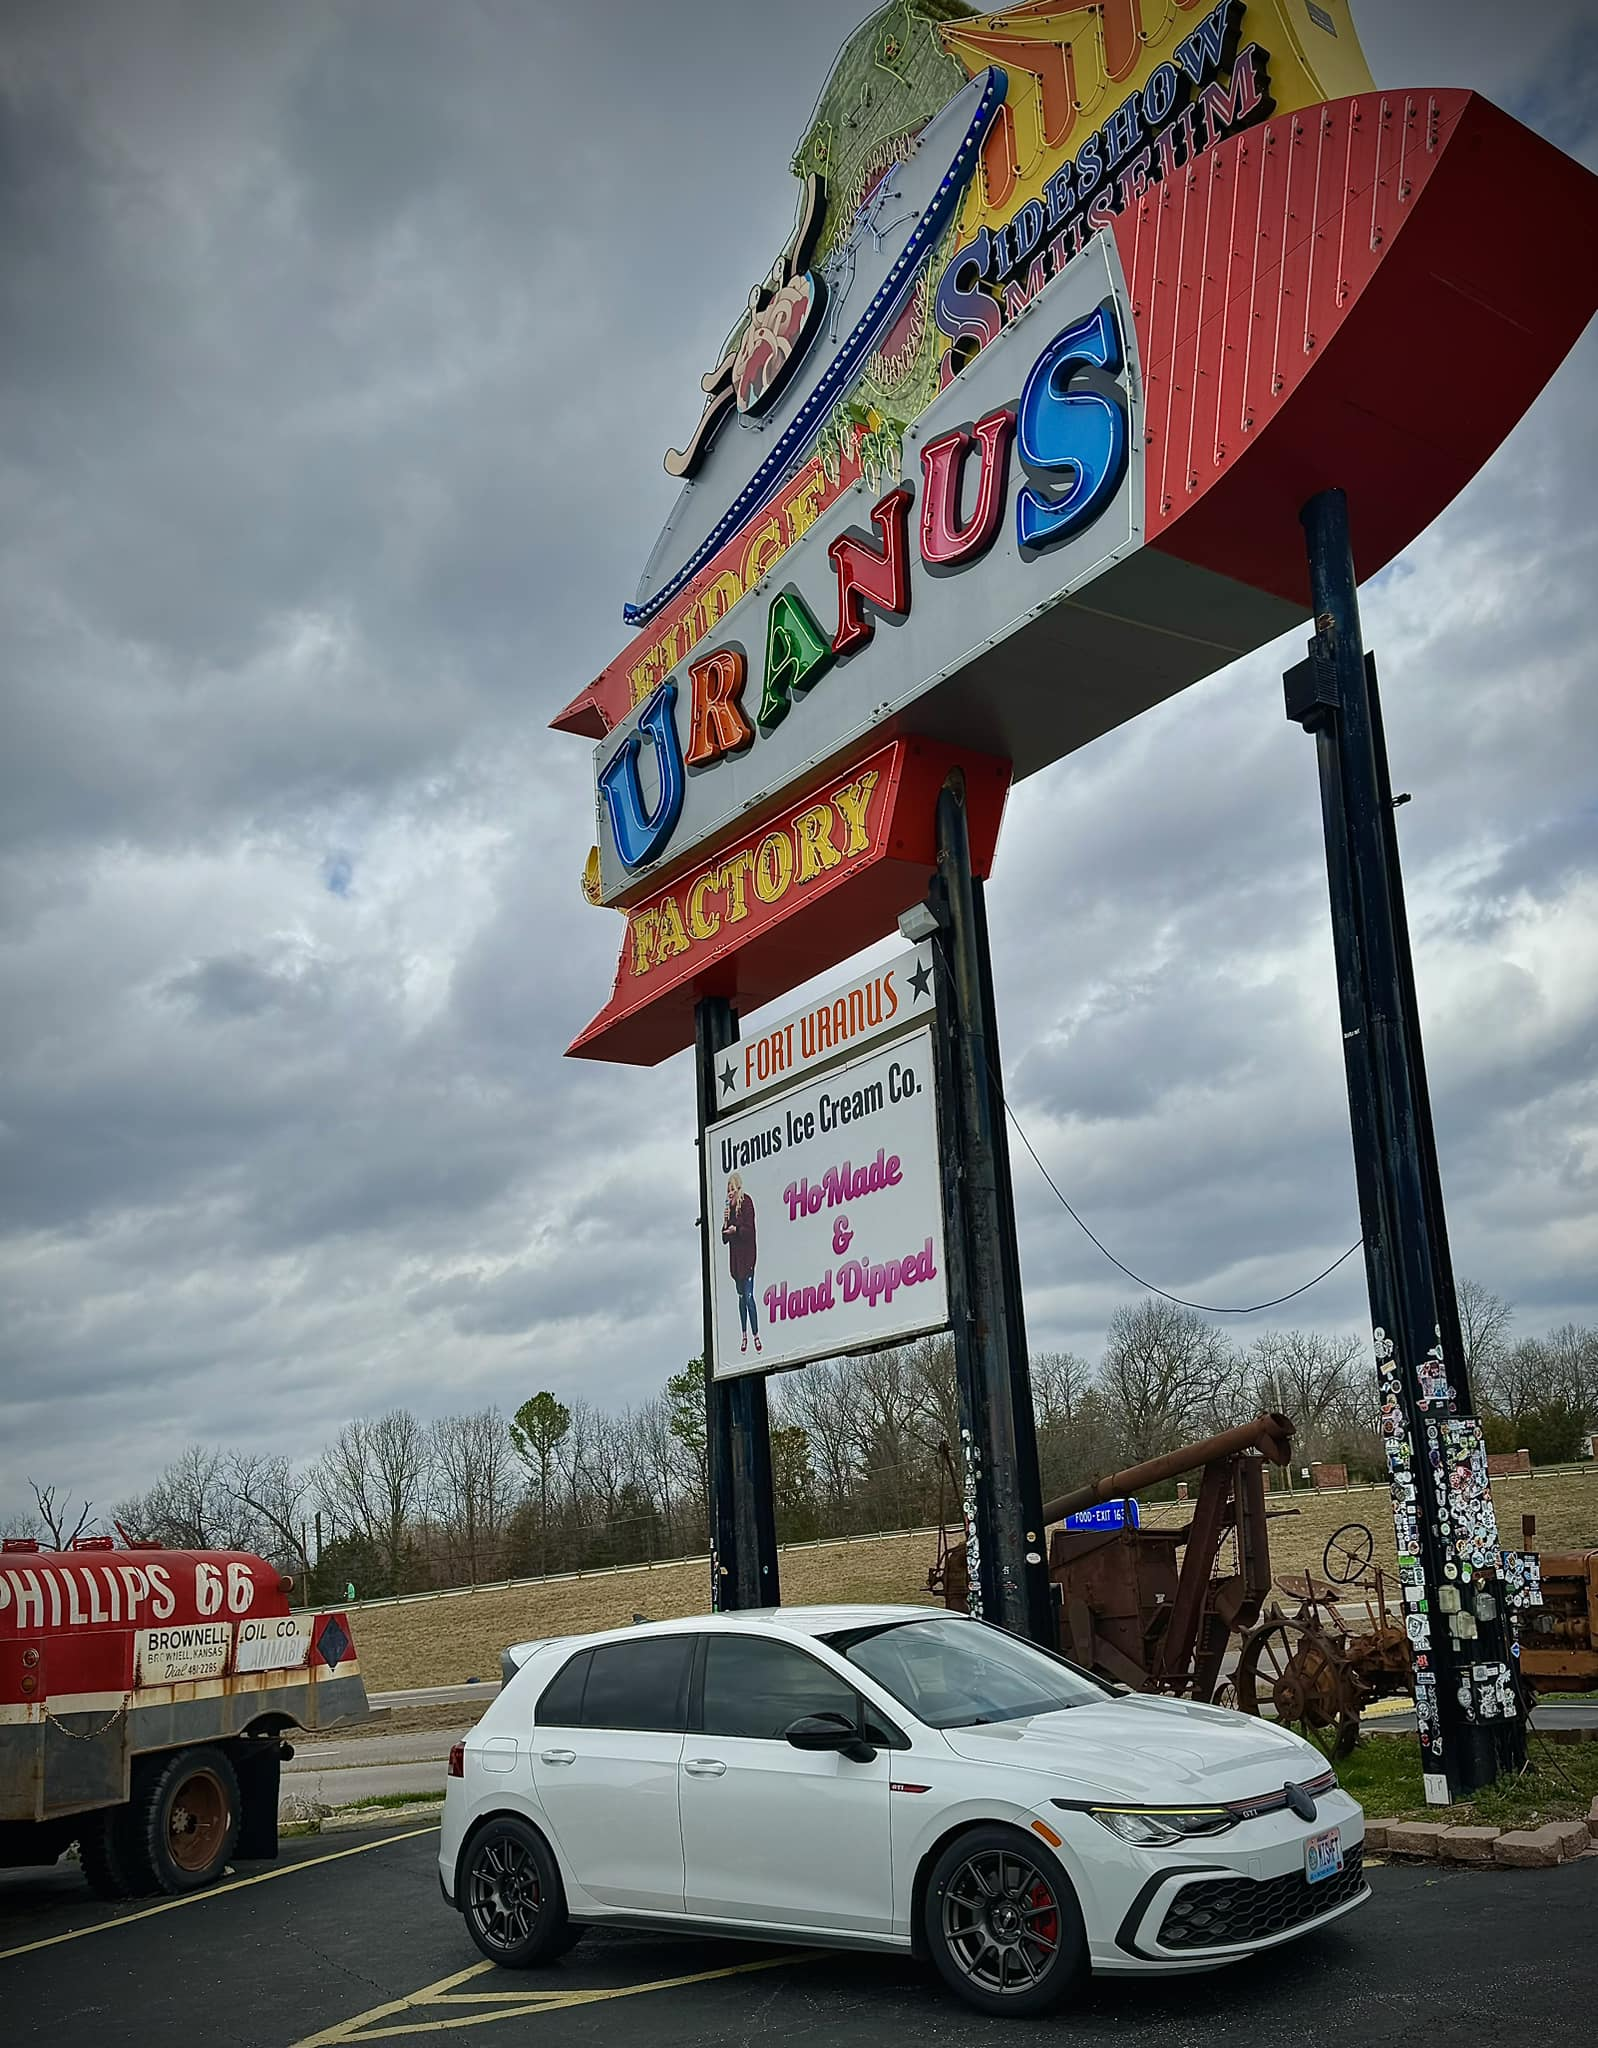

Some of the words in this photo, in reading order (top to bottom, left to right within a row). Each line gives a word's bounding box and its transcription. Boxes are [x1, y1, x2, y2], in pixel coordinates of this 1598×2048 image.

[936, 0, 1233, 394] SIDESHOW
[1002, 44, 1263, 321] MUSEUM
[601, 306, 1129, 868] URANUS
[626, 468, 826, 709] FUDGE
[629, 770, 879, 977] FACTORY
[744, 1024, 795, 1088] FORT
[801, 970, 898, 1060] URANUS
[721, 1124, 781, 1174] Uranus
[786, 1110, 815, 1146] Ice
[819, 1078, 883, 1132] Cream
[889, 1062, 922, 1105] Co.
[783, 1147, 903, 1221] HoMade
[832, 1216, 854, 1255] &
[763, 1270, 835, 1323] Hand
[836, 1237, 937, 1308] Dipped
[1075, 1512, 1092, 1524] FOOD
[1096, 1509, 1111, 1521] EXIT
[195, 1562, 254, 1616] 66
[148, 1627, 227, 1651] BROWNELL
[244, 1624, 267, 1642] OIL
[276, 1620, 300, 1638] CO.
[164, 1664, 188, 1679] Dial
[193, 1646, 223, 1660] KANSAS
[1242, 1808, 1258, 1818] GTI
